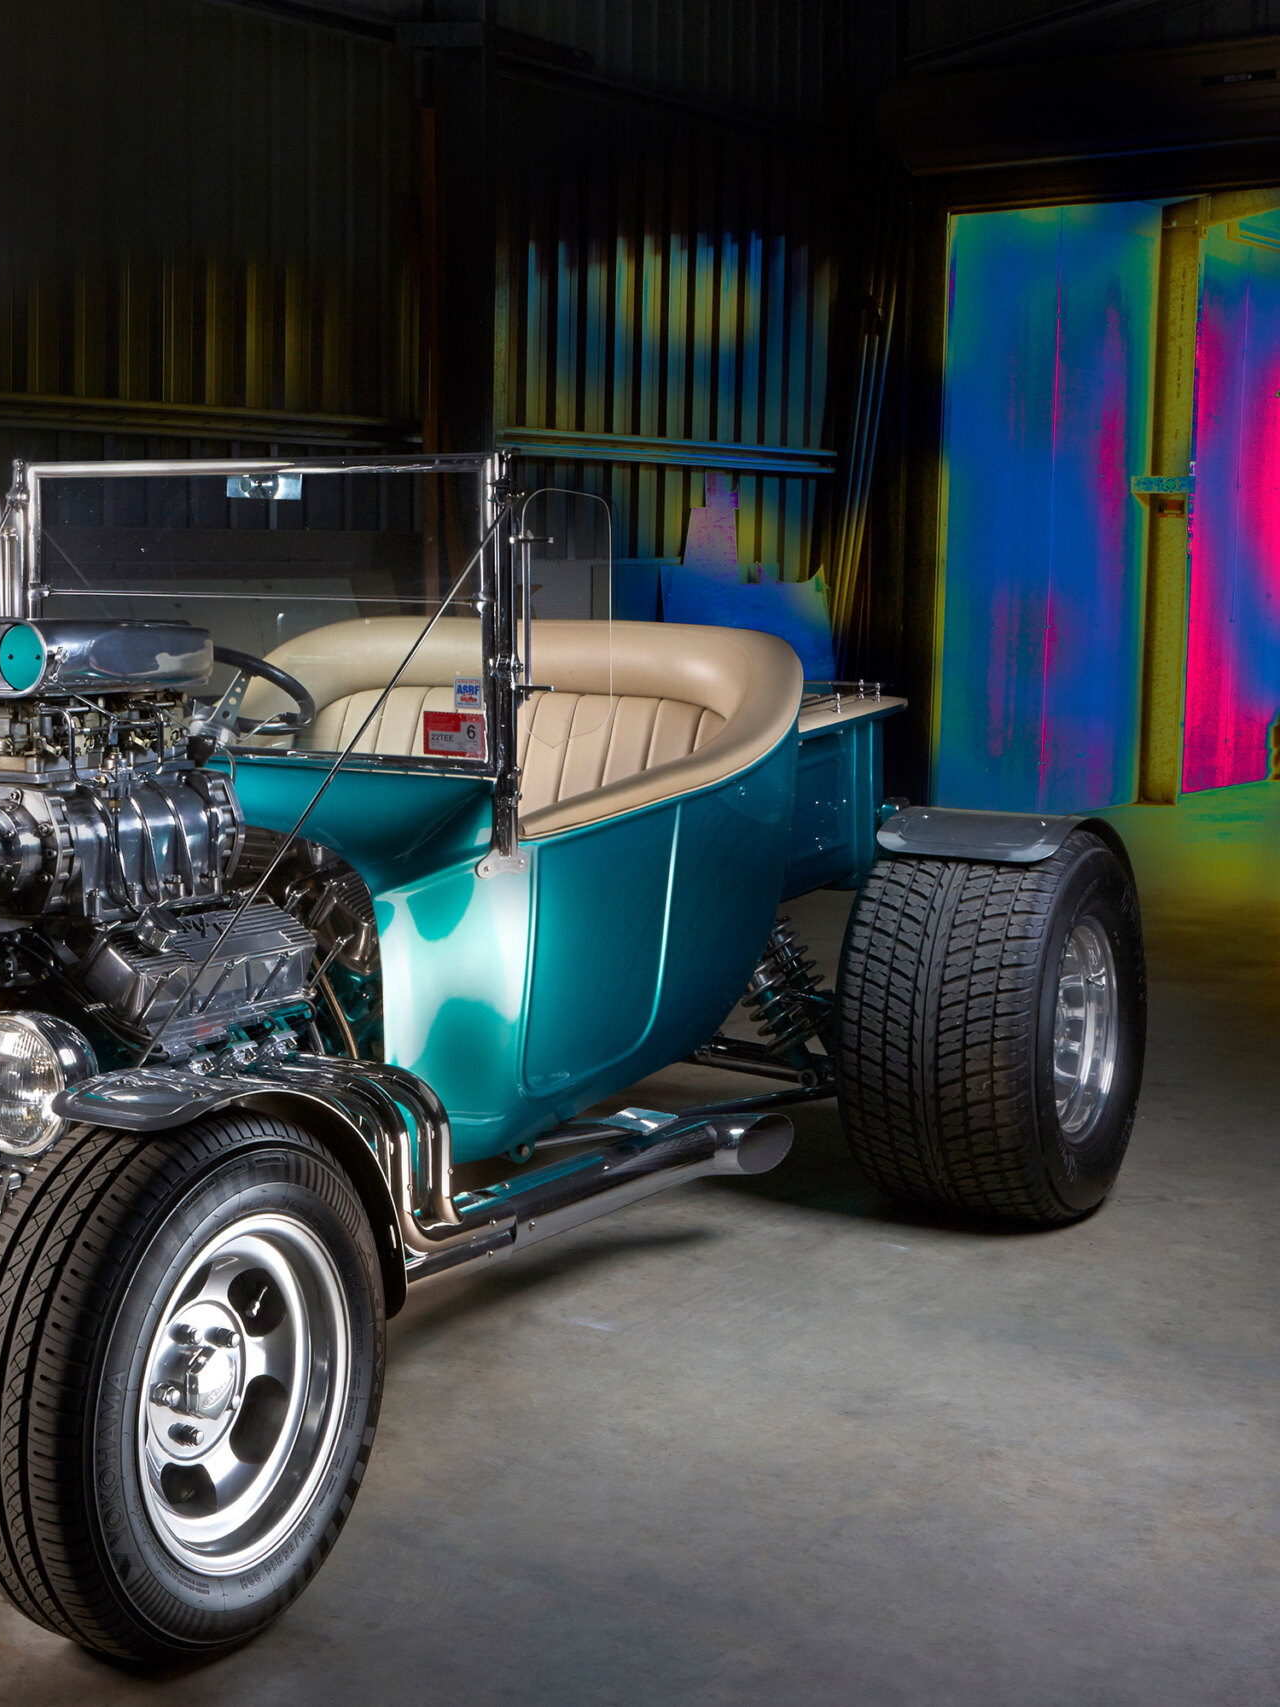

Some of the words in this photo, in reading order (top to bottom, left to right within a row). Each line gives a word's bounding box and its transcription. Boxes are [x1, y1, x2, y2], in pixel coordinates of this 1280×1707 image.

[457, 684, 480, 694] ASRF
[431, 733, 453, 742] 22TEE
[466, 724, 476, 740] 6
[98, 1371, 129, 1548] YOKOHAMA
